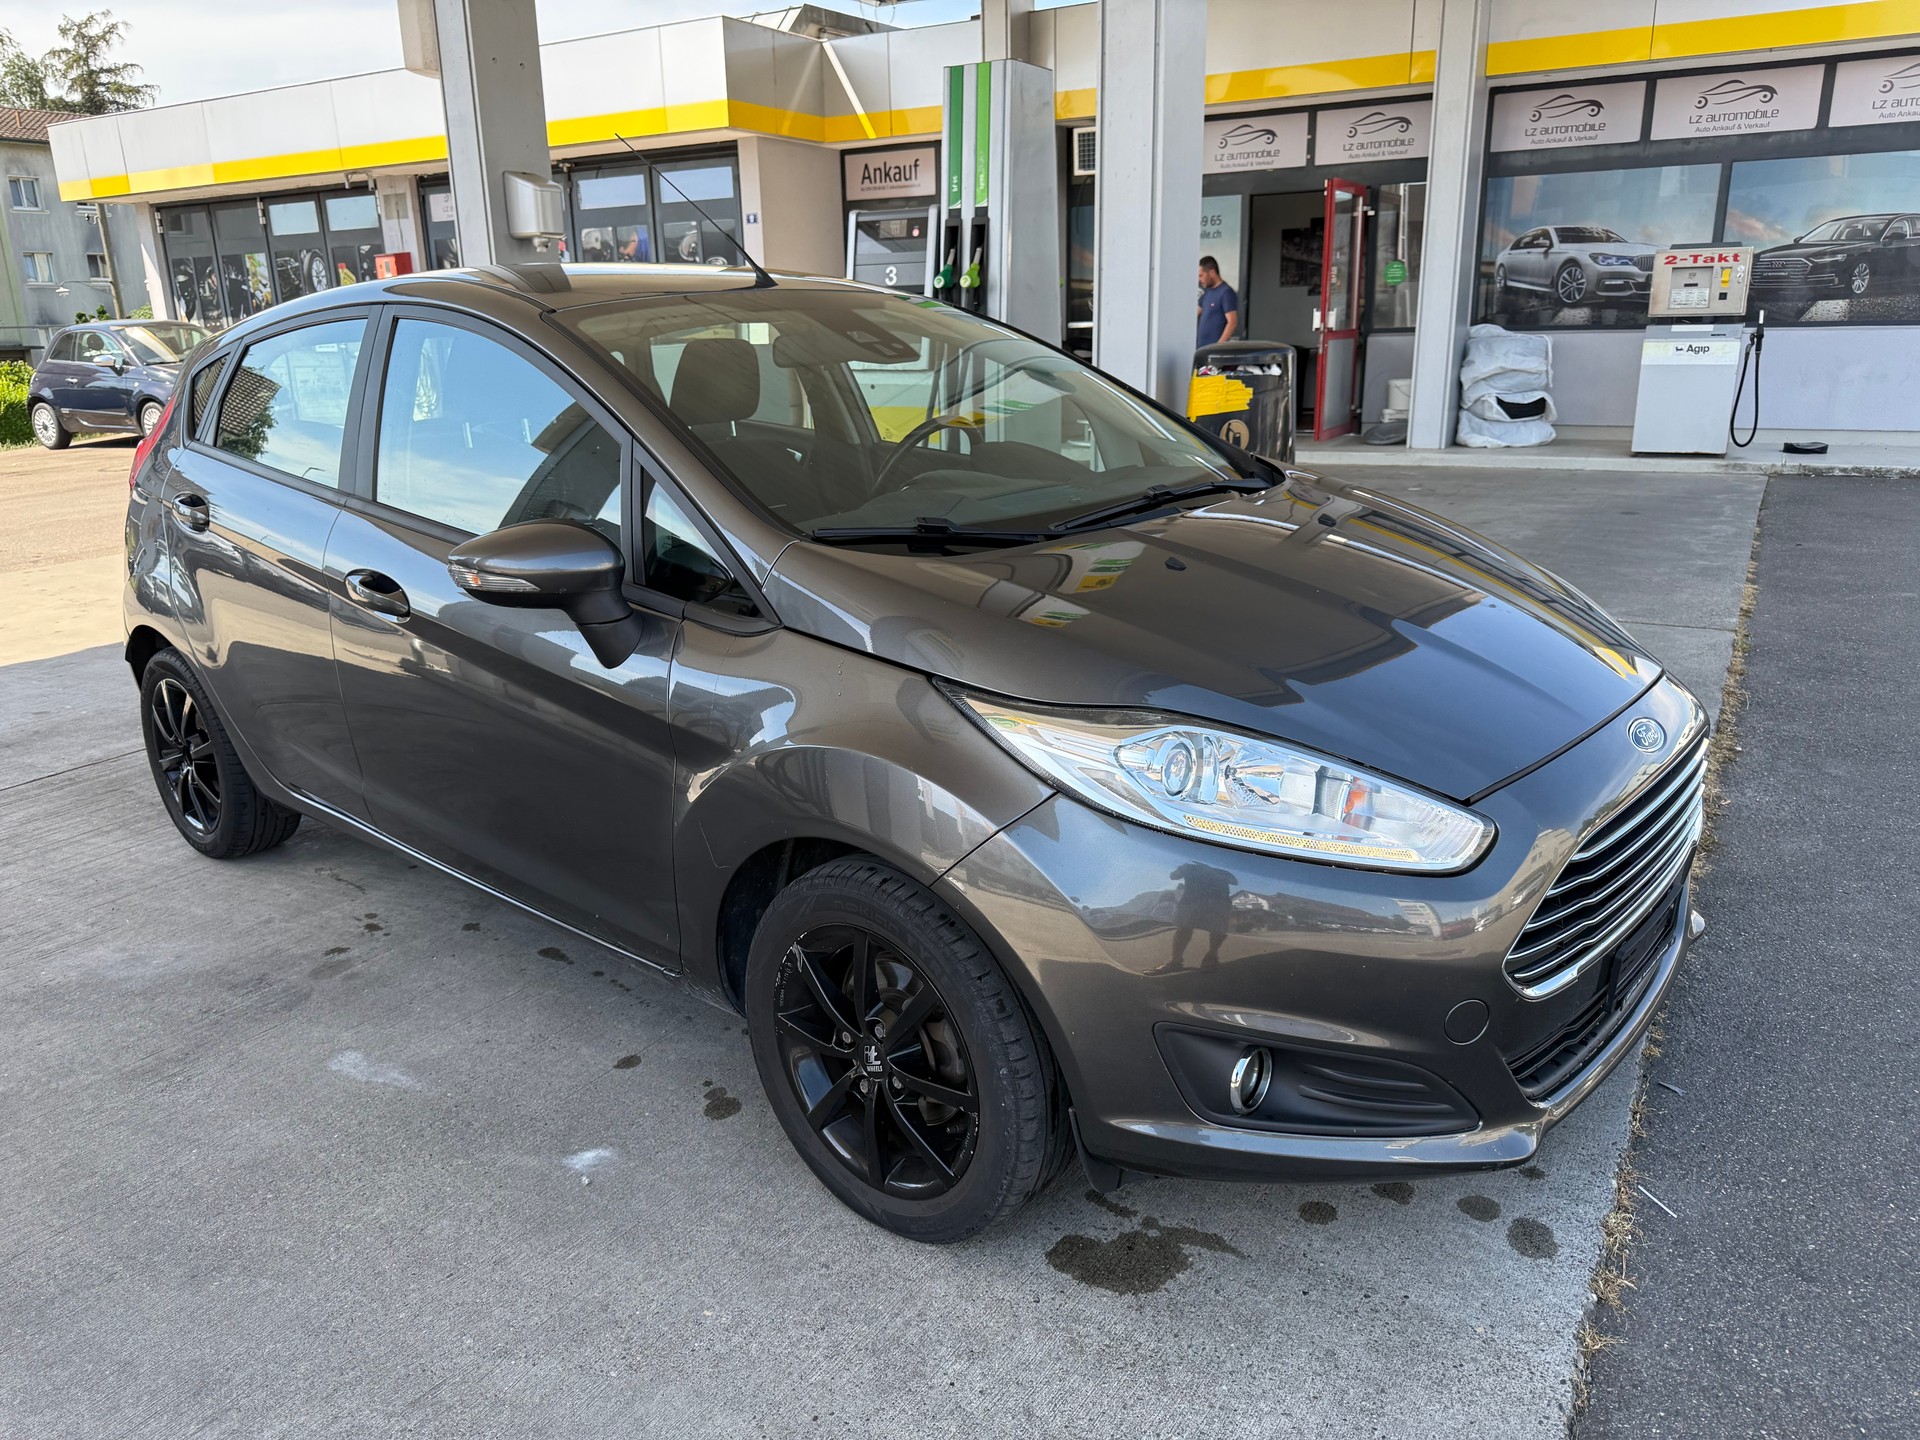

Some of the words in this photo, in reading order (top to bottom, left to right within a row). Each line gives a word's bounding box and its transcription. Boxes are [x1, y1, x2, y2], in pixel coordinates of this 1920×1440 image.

[1872, 99, 1888, 110] LZ
[1689, 115, 1703, 124] LZ
[1878, 111, 1896, 119] Auto
[1711, 123, 1736, 132] Ankauf
[1743, 121, 1771, 129] Verkauf
[1525, 128, 1538, 137] LZ
[1545, 136, 1567, 144] Ankauf
[1573, 134, 1599, 142] Verkauf
[1343, 143, 1354, 152] LZ
[1214, 153, 1226, 161] LZ
[861, 158, 920, 185] Ankauf
[1210, 214, 1222, 227] 65
[1664, 253, 1741, 265] 2-Takt
[884, 265, 897, 285] 3
[1686, 344, 1710, 354] Agip
[1636, 725, 1658, 746] Ford
